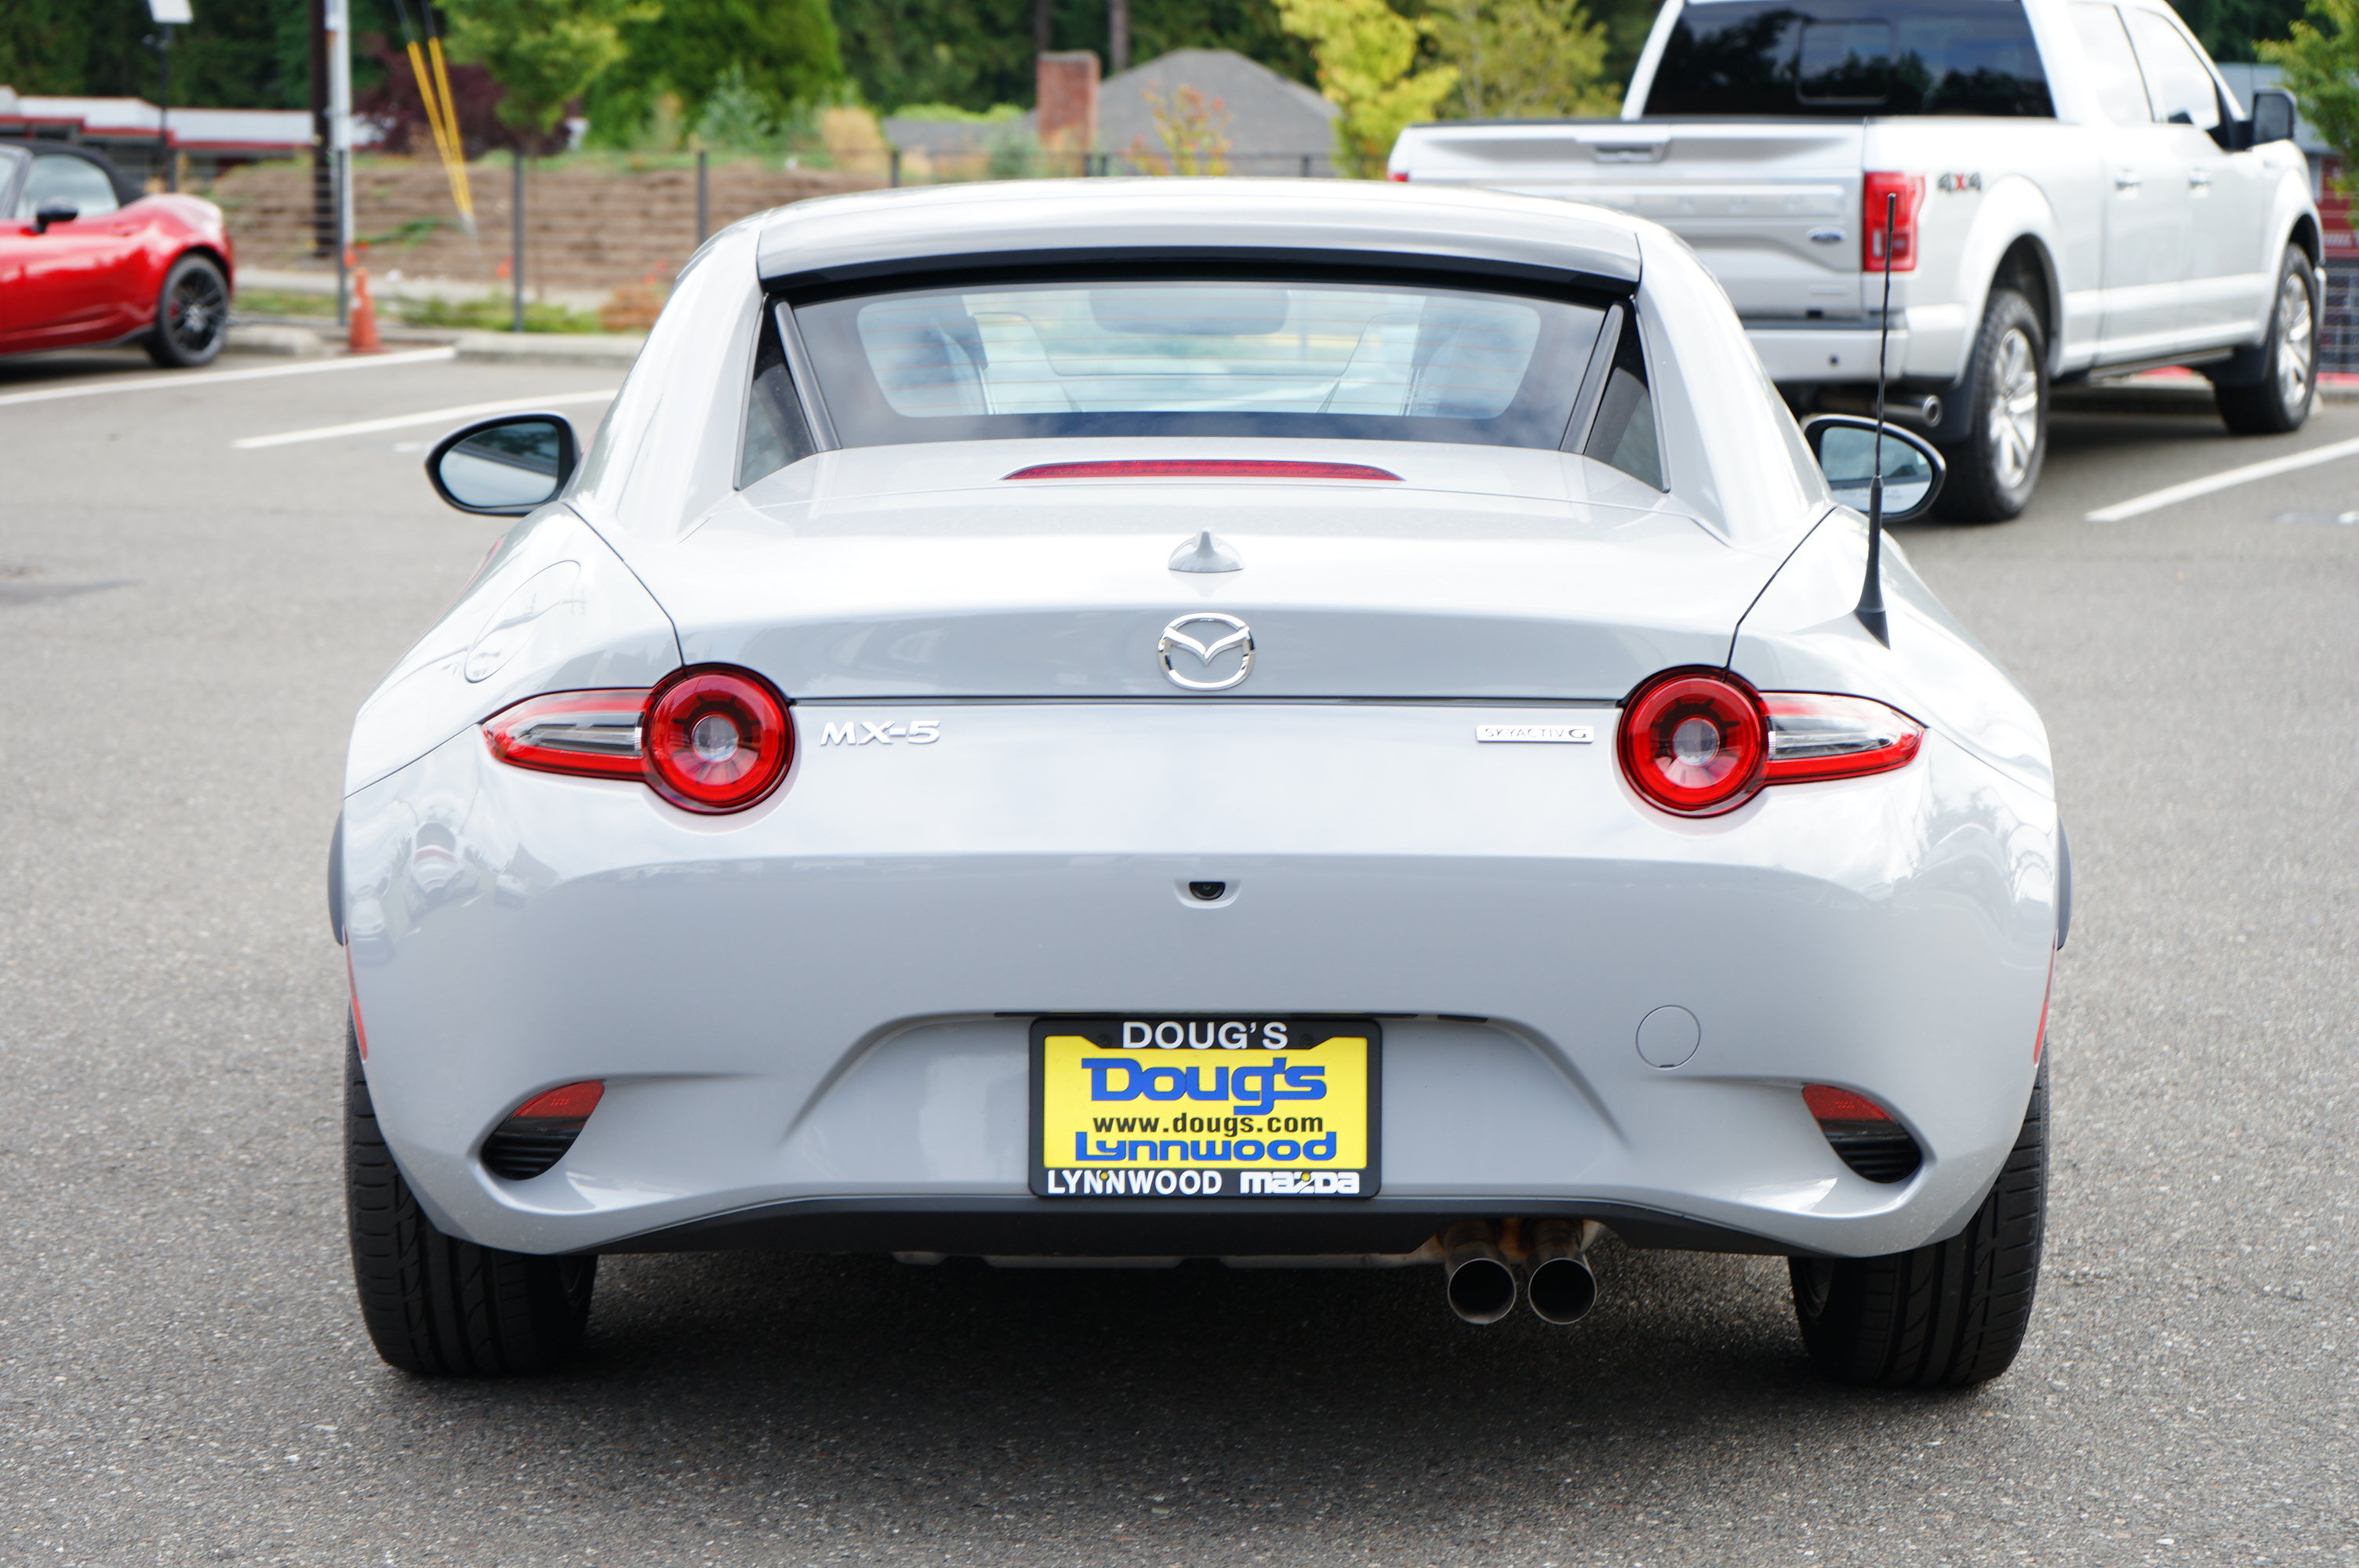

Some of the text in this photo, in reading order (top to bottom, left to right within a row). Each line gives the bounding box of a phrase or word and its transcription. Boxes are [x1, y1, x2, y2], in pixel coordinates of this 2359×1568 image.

[820, 720, 940, 746] MX-5
[1122, 1022, 1288, 1049] DOUG'S
[1081, 1057, 1327, 1115] Doug's
[1093, 1112, 1323, 1137] www.dougs.com
[1075, 1131, 1337, 1161] Lynnwood
[1048, 1170, 1223, 1195] LYNNWOOD
